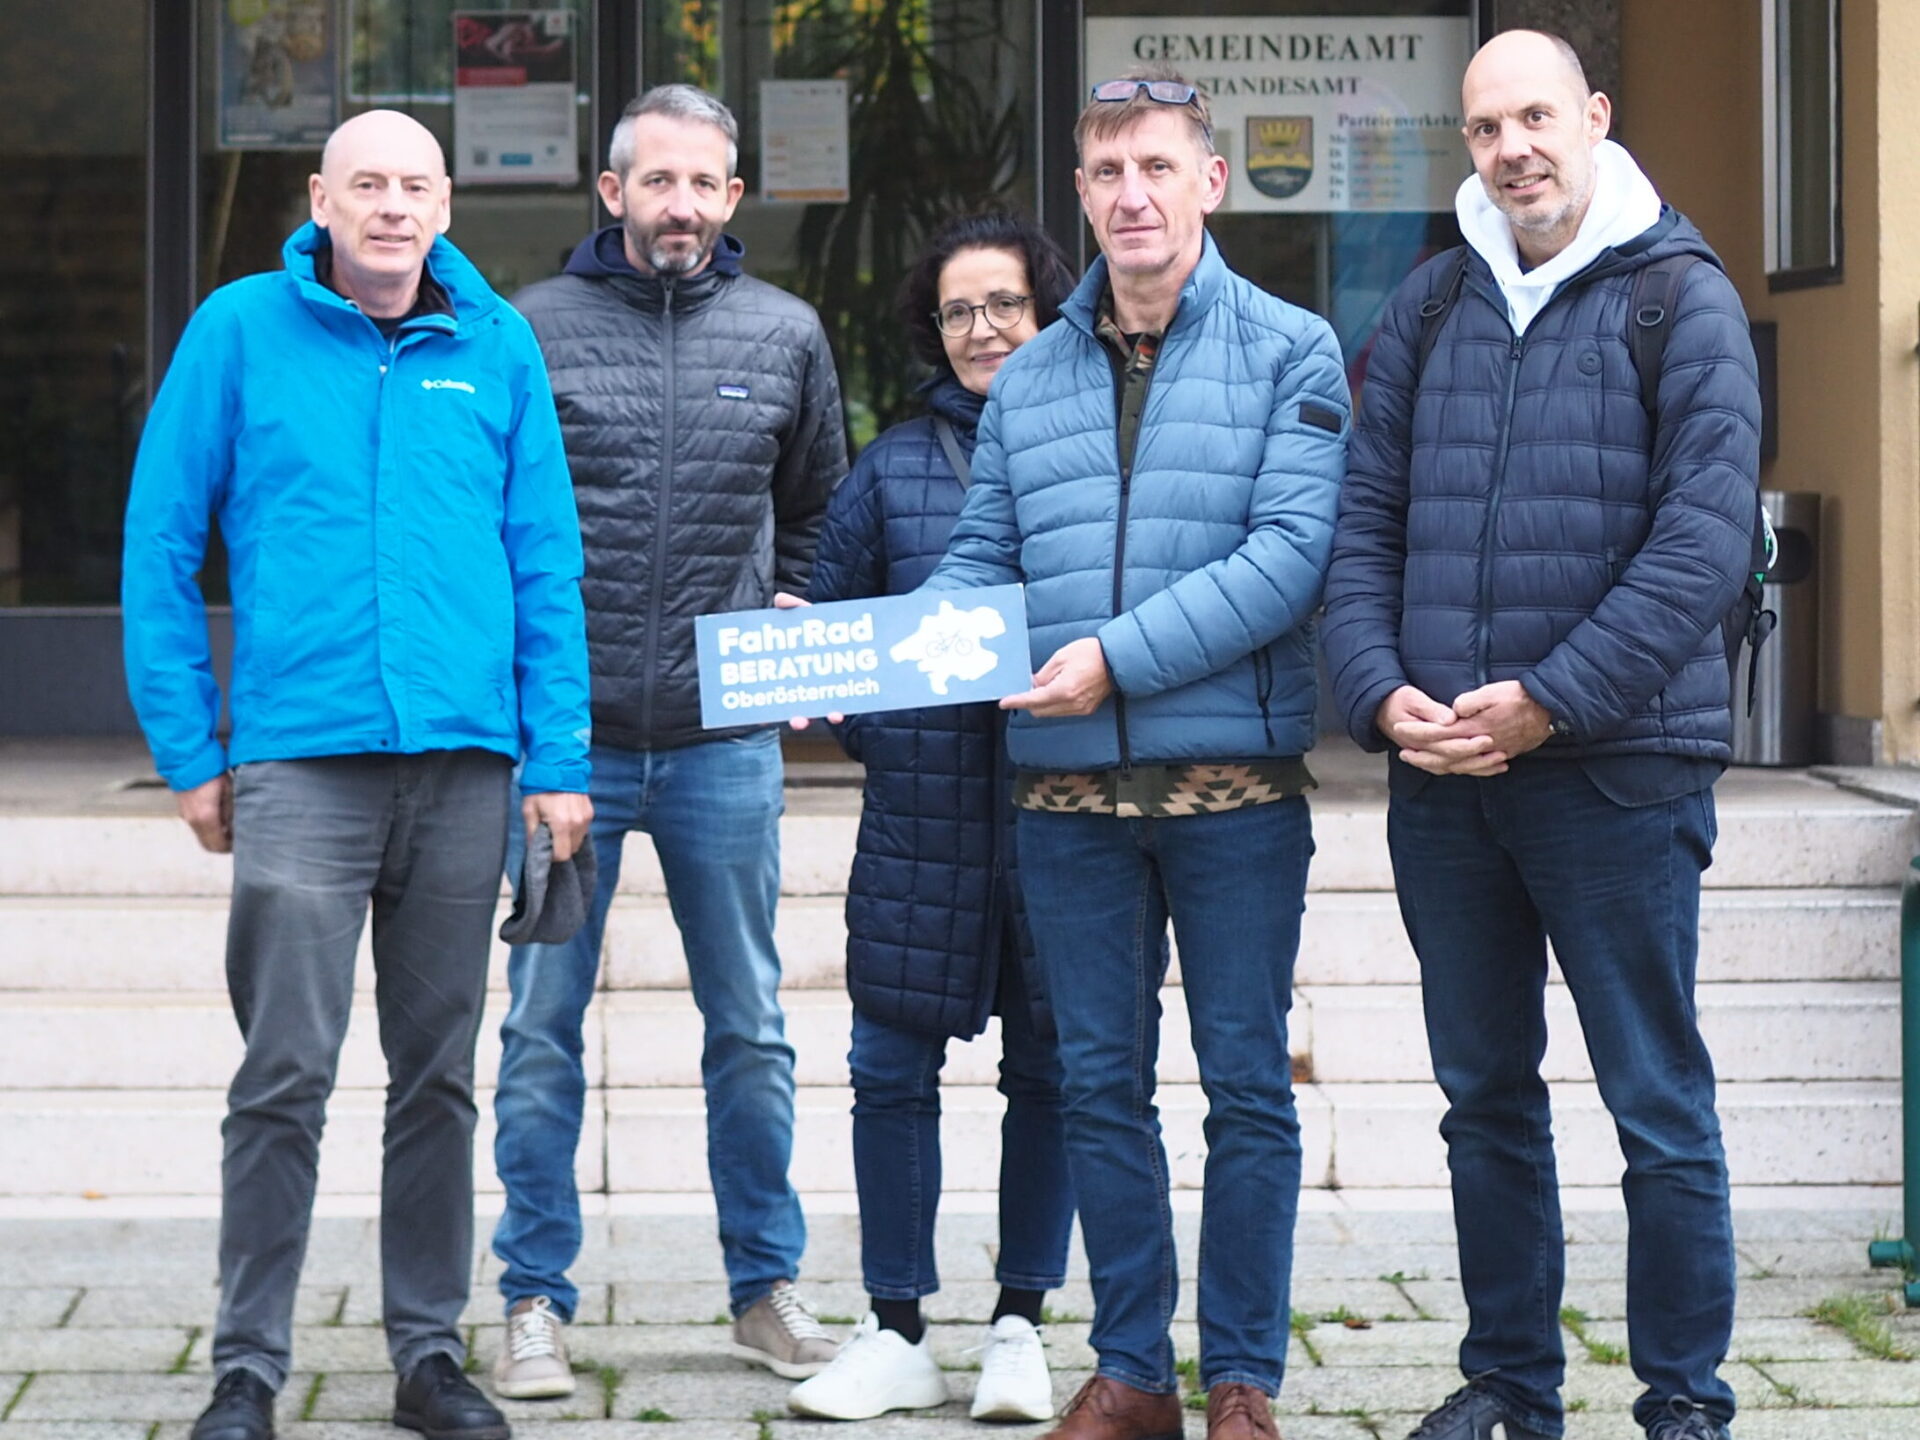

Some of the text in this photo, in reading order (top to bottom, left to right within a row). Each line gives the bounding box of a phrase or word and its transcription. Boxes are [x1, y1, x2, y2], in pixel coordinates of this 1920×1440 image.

[1133, 34, 1422, 61] GEMEINDEAMT
[1195, 76, 1361, 95] STANDESAMT
[718, 613, 874, 656] FahrRad
[720, 648, 879, 686] BERATUNG
[721, 677, 880, 710] Oberösterreich
